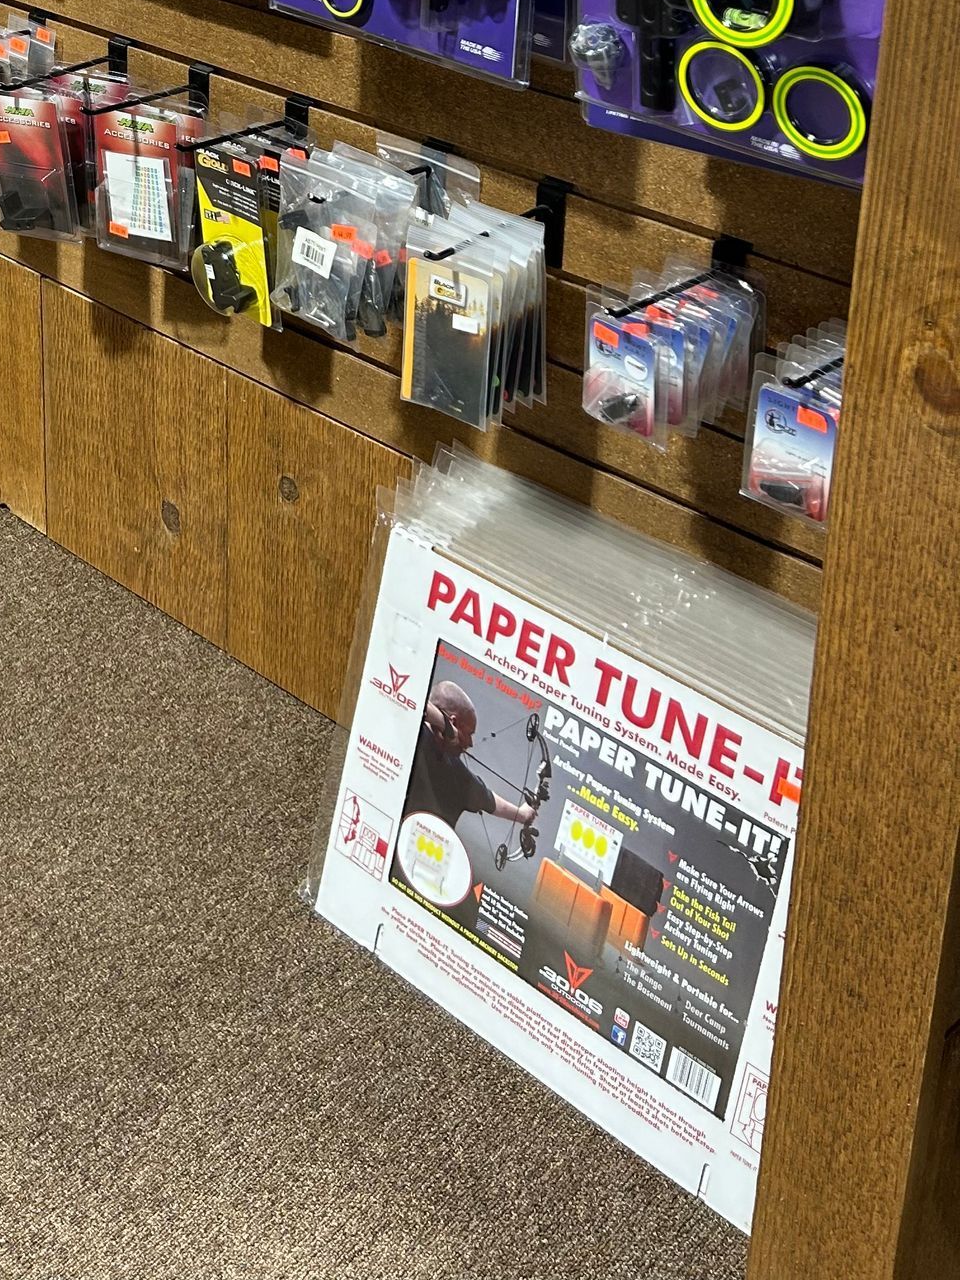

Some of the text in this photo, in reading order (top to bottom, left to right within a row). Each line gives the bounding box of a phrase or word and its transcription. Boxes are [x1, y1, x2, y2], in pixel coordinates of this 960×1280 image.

[103, 128, 170, 150] ACCESSORIES
[198, 153, 229, 172] GOLD
[427, 569, 804, 807] PAPER TUNE-I
[484, 648, 529, 681] Archery
[531, 674, 567, 702] Paper
[570, 695, 611, 730] Tuning
[613, 720, 663, 757] System.
[666, 750, 704, 780] Made
[708, 774, 742, 803] Easy.
[359, 734, 403, 770] WARNING:
[544, 705, 783, 858] PAPER TUNE-IT!
[552, 754, 676, 836] Archery Paper Tuning System
[570, 803, 610, 832] PAPER TUNE
[611, 806, 640, 833] Easy.
[763, 810, 789, 832] Patent
[672, 885, 737, 934] Take the Fish Tail
[676, 872, 736, 913] are Flying Right
[678, 858, 765, 919] Make Sure Your Arrows
[666, 910, 733, 960] Easy Step-by-Step
[670, 897, 730, 941] Out of Your Shot
[660, 935, 729, 987] Sets Up in Seconds
[664, 921, 718, 964] Archery Tuning
[623, 971, 673, 1012] The Basement
[624, 940, 672, 978] Lightweight
[672, 972, 680, 985] &
[681, 978, 718, 1009] Portable
[626, 959, 663, 991] The Range
[550, 982, 592, 1015] OUTDOORS
[684, 1000, 726, 1035] Deer Camp
[682, 1011, 730, 1051] Tournaments
[526, 1005, 553, 1028] platform
[573, 1040, 596, 1059] proper
[597, 1057, 626, 1082] shooting
[626, 1077, 649, 1098] height
[658, 1101, 678, 1119] shoot
[678, 1115, 707, 1139] through
